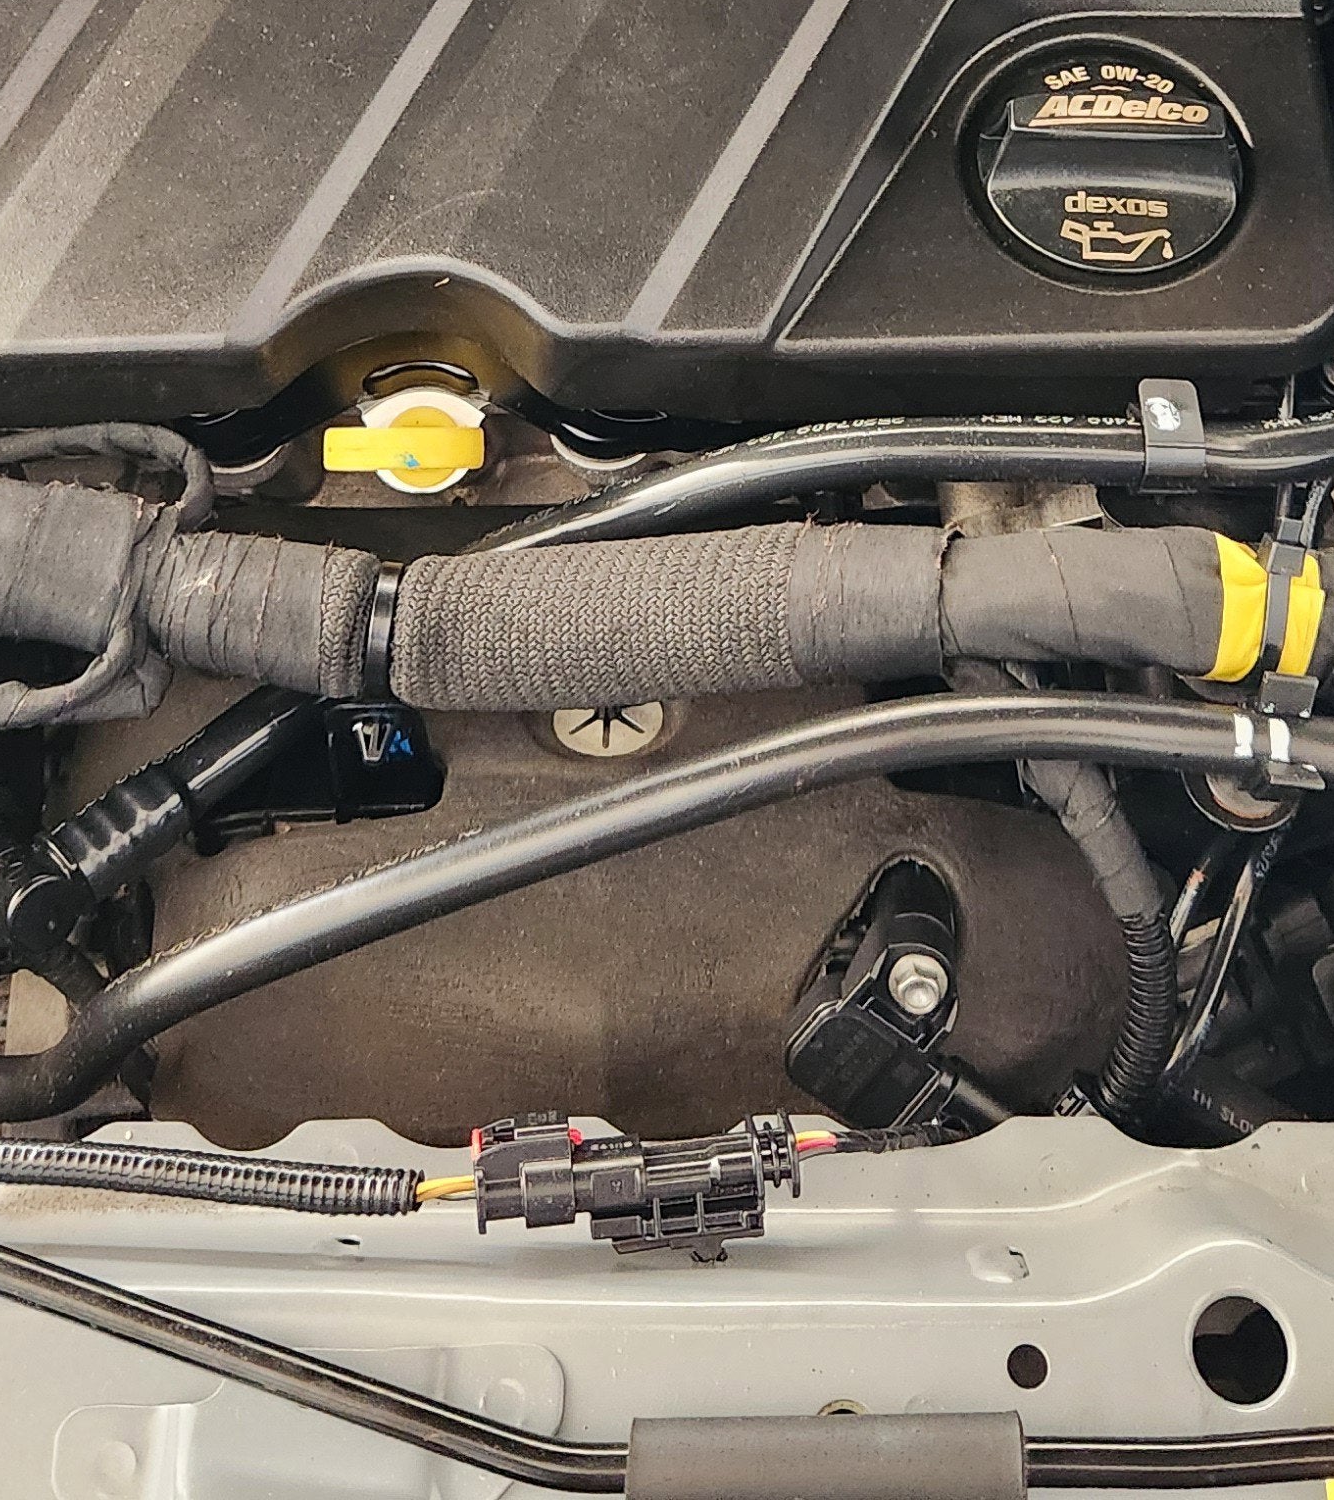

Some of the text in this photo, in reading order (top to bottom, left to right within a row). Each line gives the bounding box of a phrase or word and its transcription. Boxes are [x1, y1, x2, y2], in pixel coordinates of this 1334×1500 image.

[1043, 64, 1175, 95] SAE 0W-20
[1033, 94, 1211, 124] ACDelco
[1064, 190, 1169, 219] dexos
